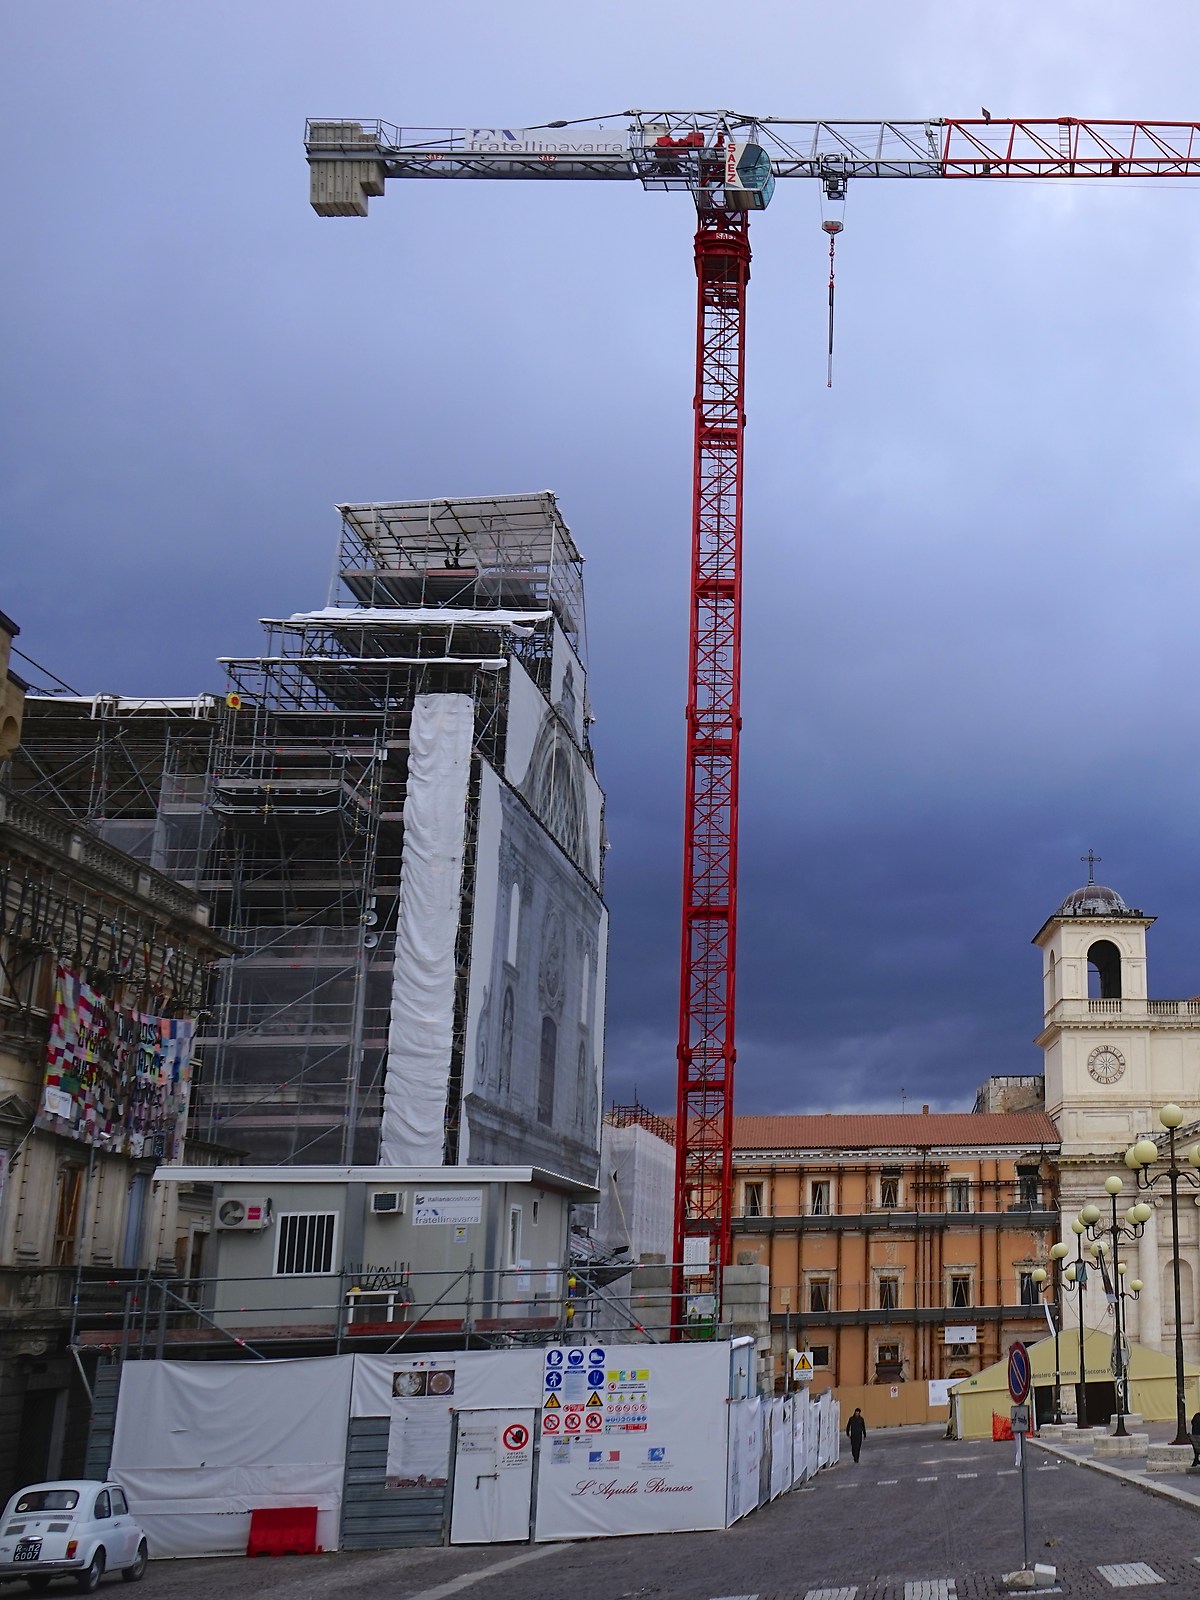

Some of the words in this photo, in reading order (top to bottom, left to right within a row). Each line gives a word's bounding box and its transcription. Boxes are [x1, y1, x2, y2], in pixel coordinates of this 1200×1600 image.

[727, 143, 736, 183] SAEZ
[415, 1215, 479, 1224] fratellinavarra
[571, 1479, 638, 1499] L'Aquila
[644, 1477, 693, 1494] Rinasce
[14, 1552, 39, 1560] 6007
